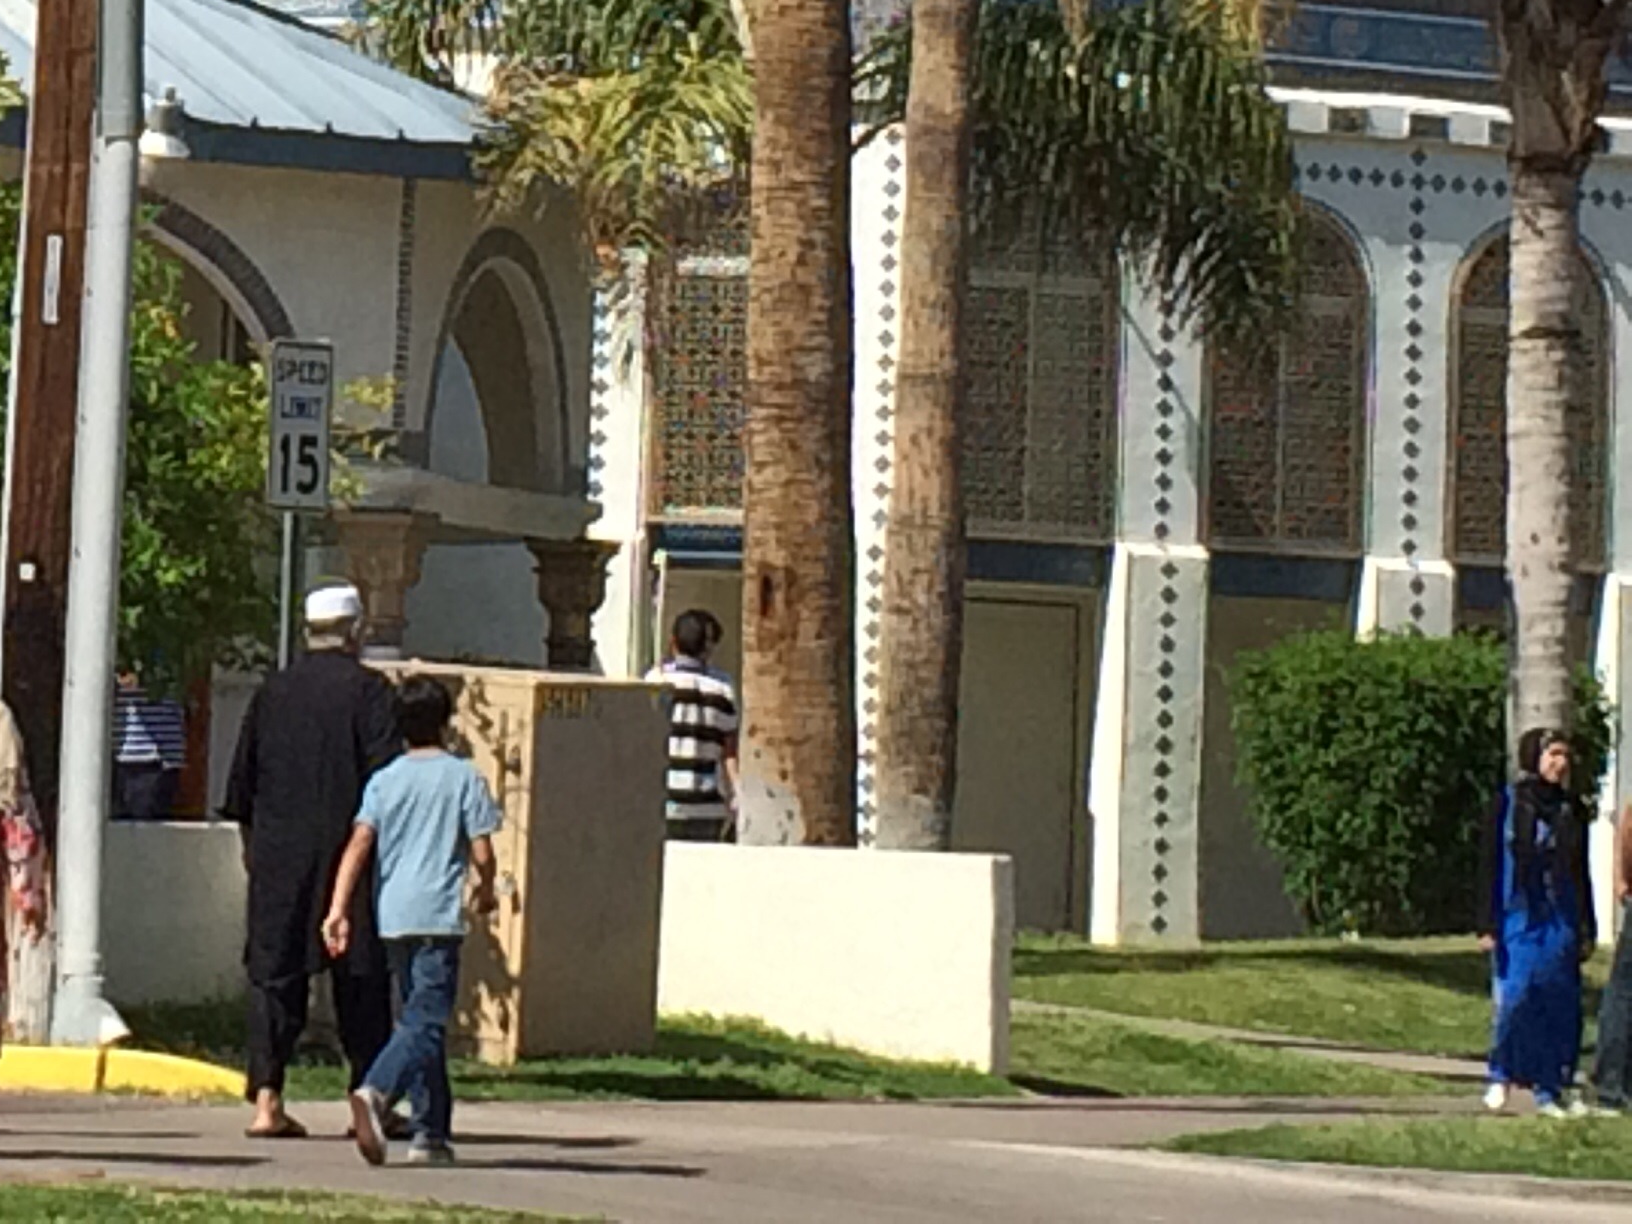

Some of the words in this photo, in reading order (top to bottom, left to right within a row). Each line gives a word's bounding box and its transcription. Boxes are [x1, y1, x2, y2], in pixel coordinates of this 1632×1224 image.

[277, 359, 328, 384] SPEED
[281, 394, 322, 419] LIMIT
[280, 433, 319, 494] 15
